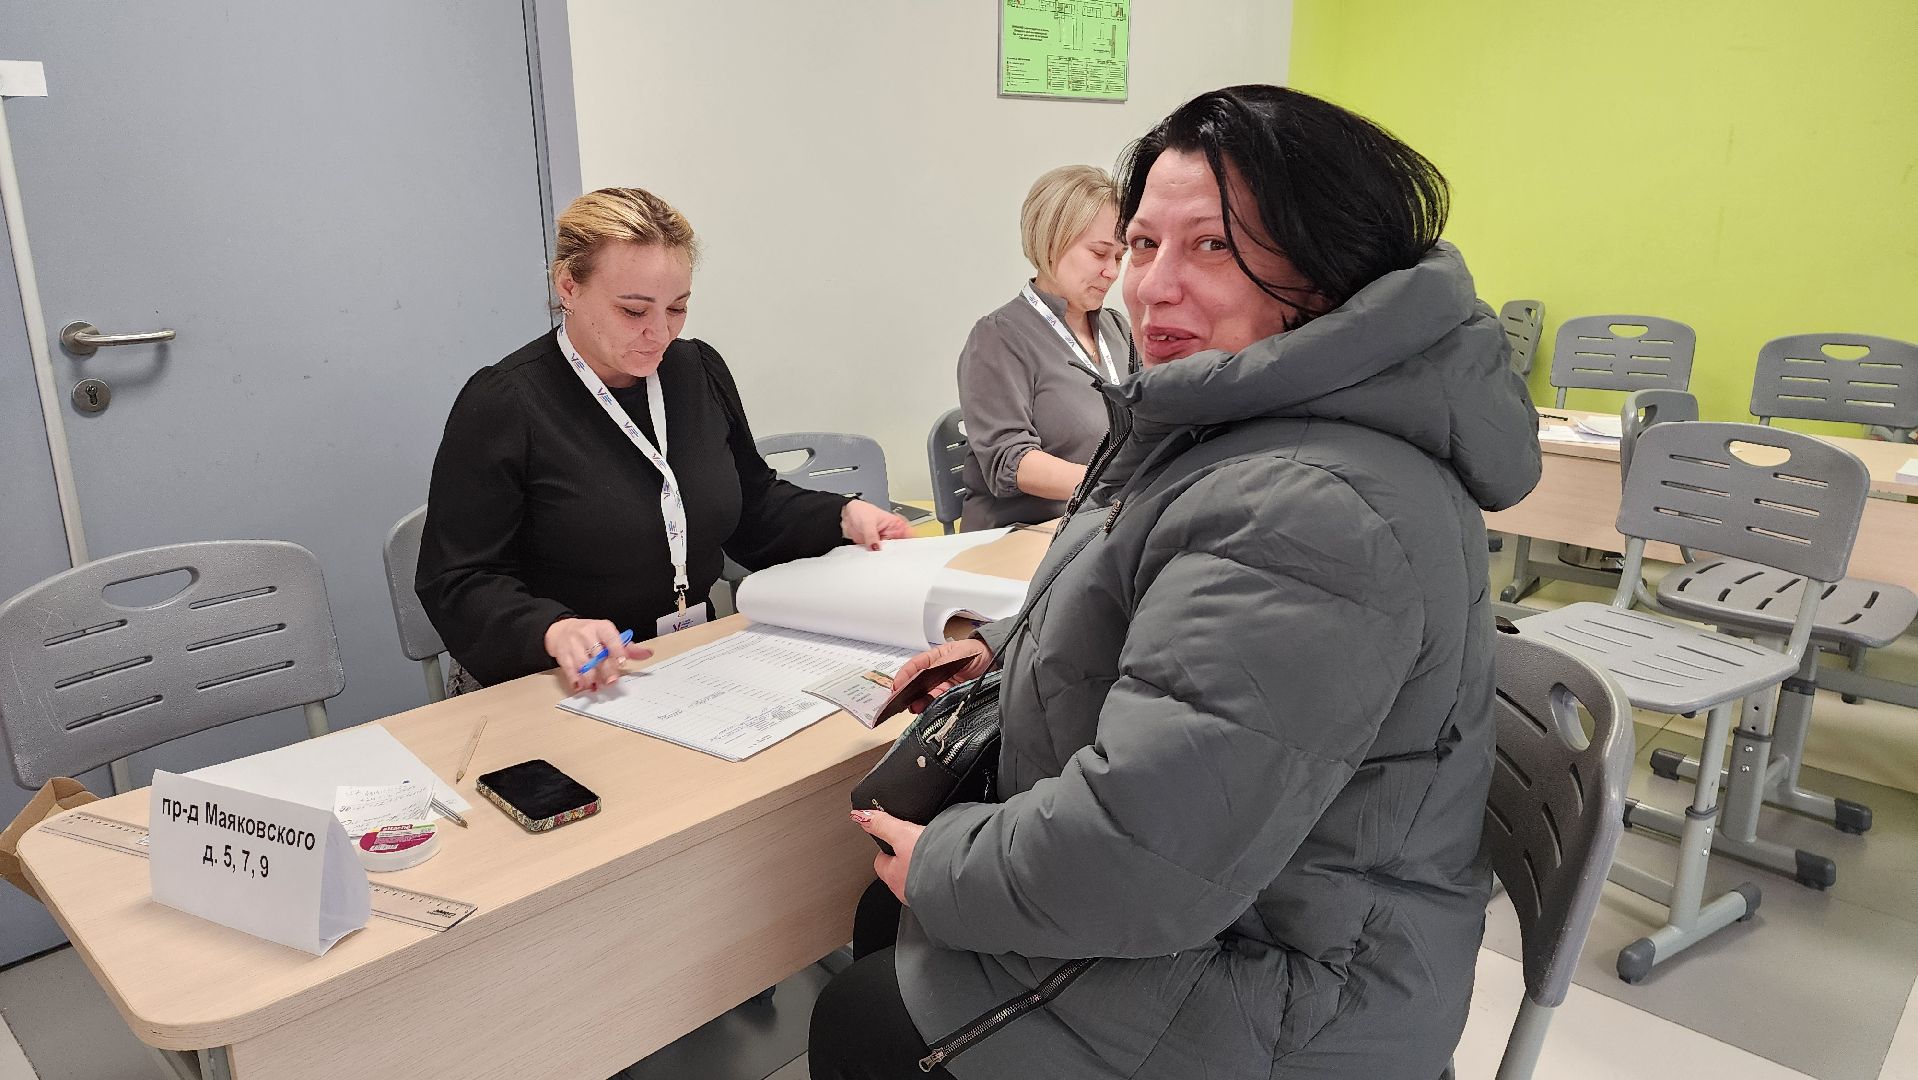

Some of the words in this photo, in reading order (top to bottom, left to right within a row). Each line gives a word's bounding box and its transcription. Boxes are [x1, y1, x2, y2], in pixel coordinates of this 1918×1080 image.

[162, 798, 199, 825] пр-д
[205, 802, 315, 850] Маяковского
[202, 844, 218, 867] д.
[223, 845, 236, 874] 5,
[241, 850, 255, 879] 7,
[260, 855, 269, 878] 9
